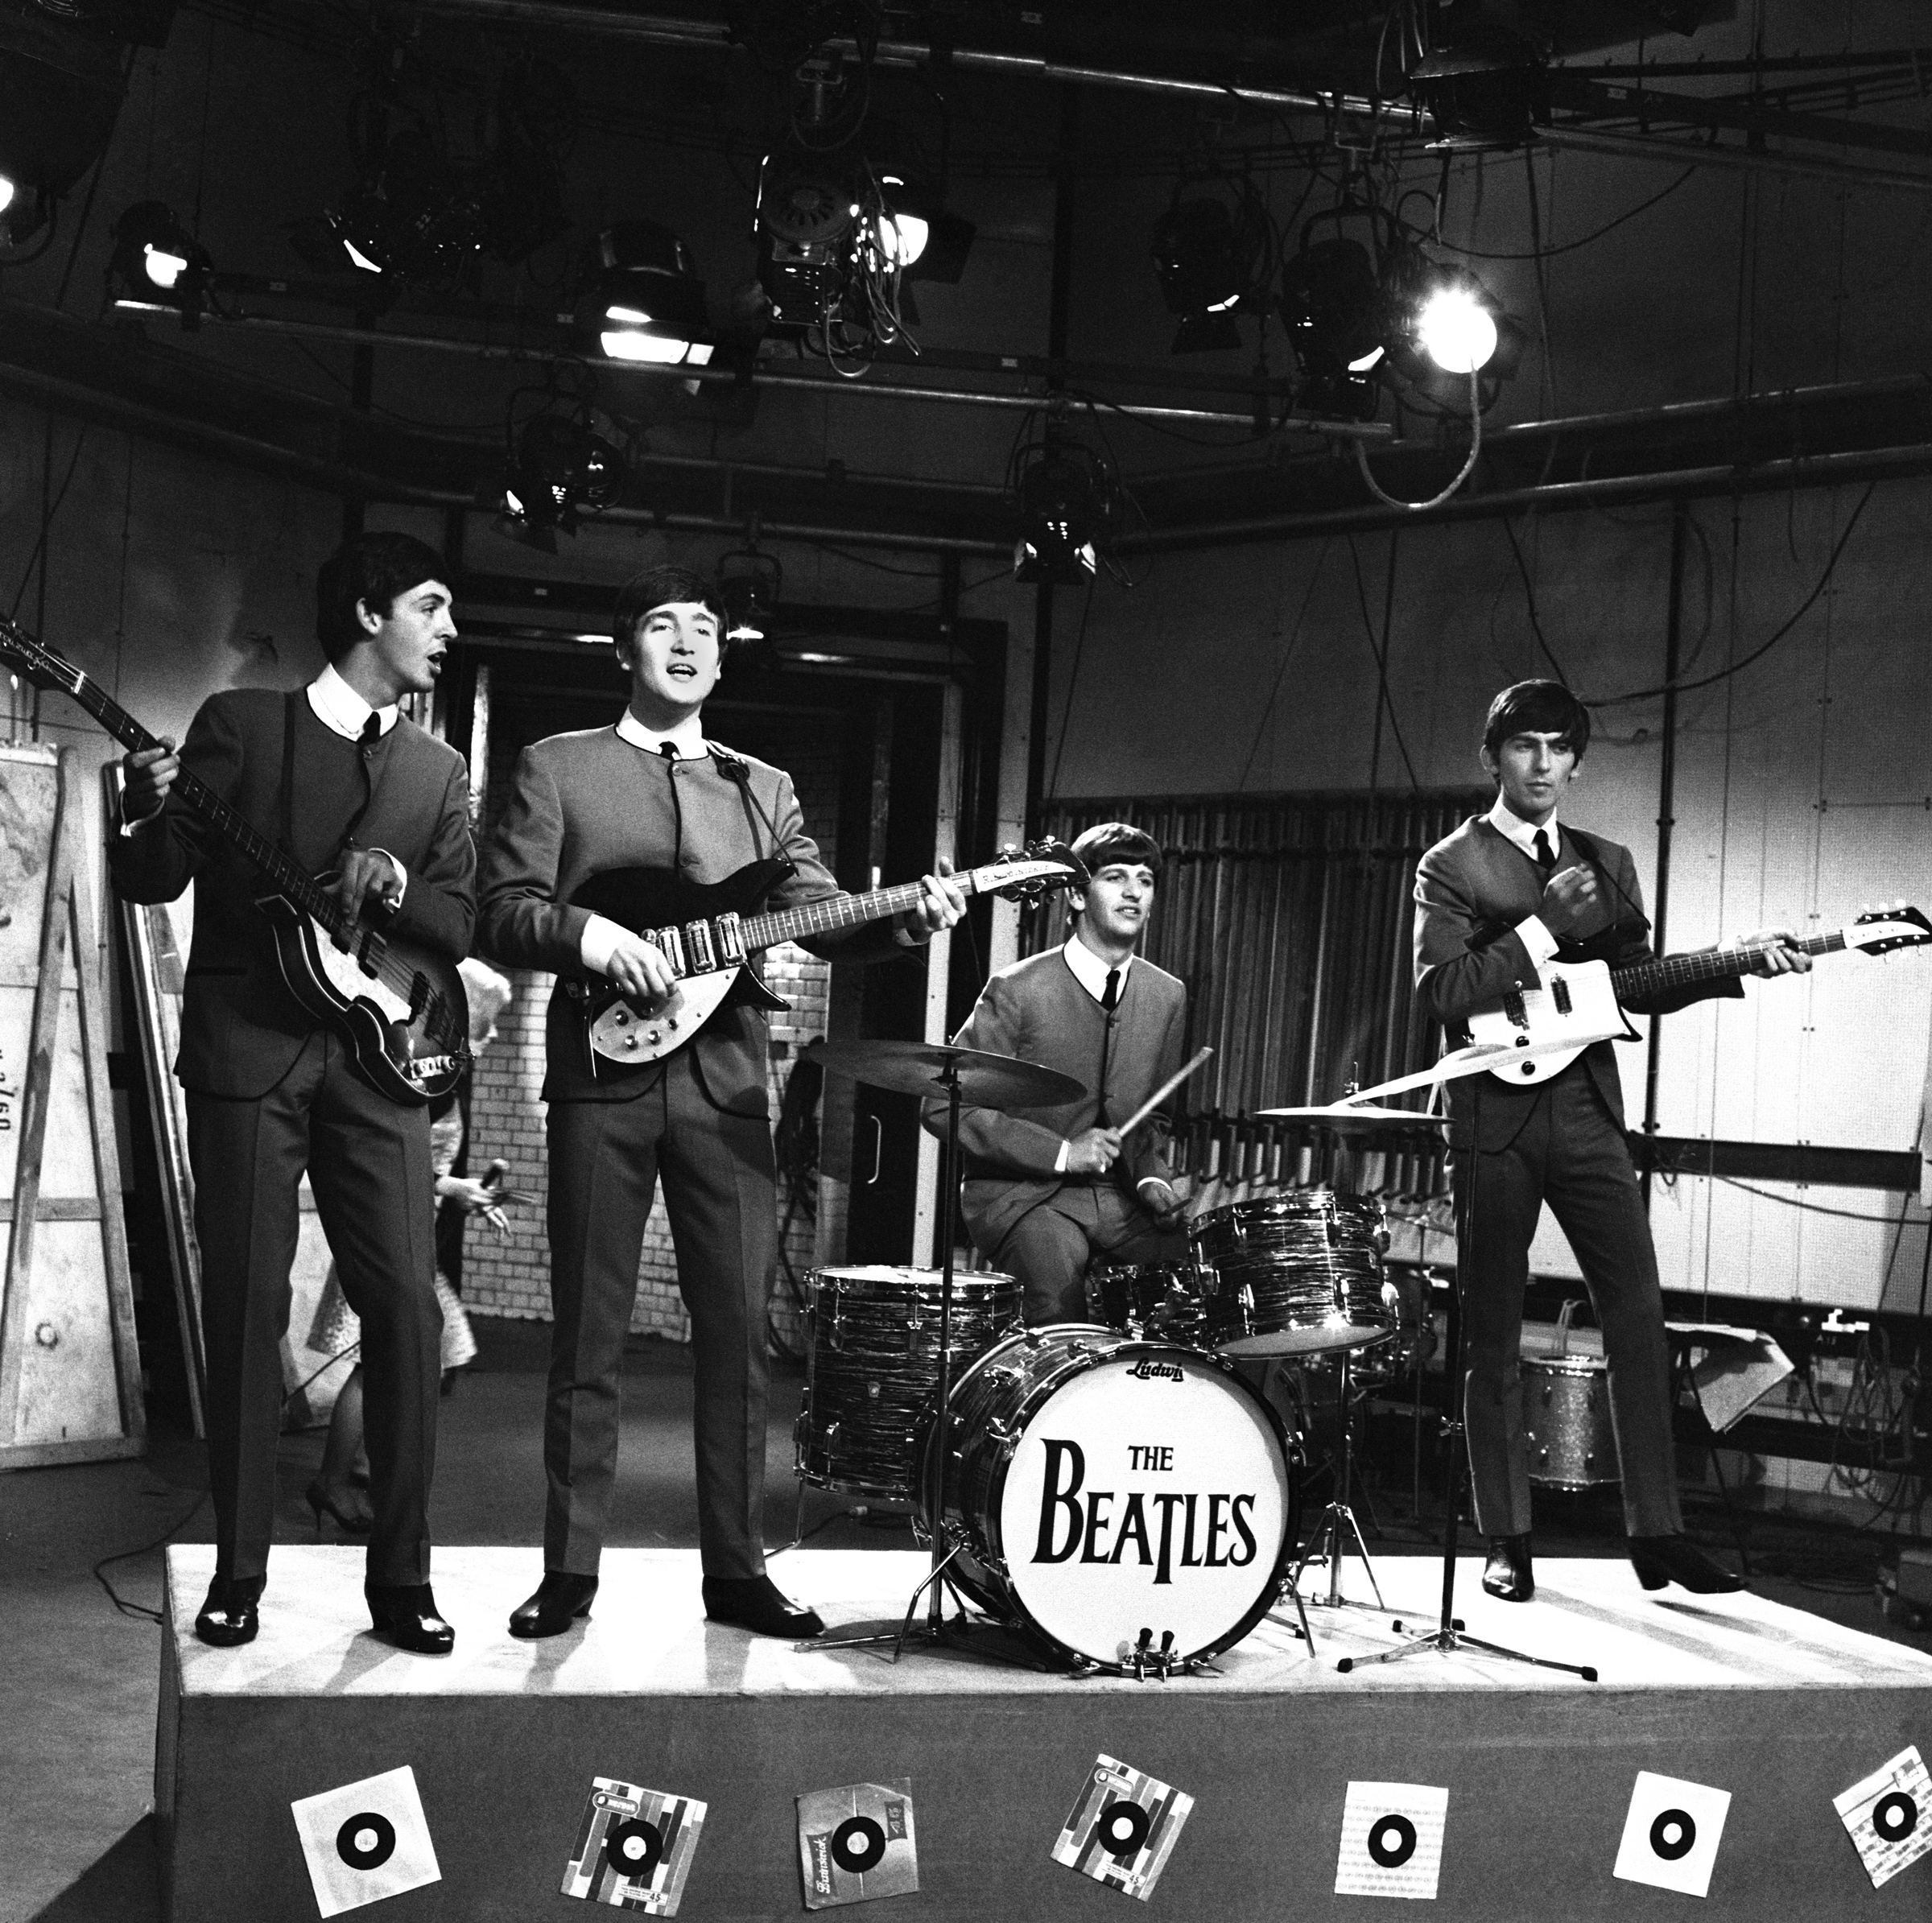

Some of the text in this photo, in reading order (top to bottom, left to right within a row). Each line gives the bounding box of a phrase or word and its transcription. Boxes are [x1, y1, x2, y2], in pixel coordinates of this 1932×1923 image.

[1128, 1445, 1174, 1471] THE
[1030, 1438, 1257, 1584] BEATLES
[1129, 1874, 1140, 1885] 45
[650, 1892, 662, 1902] 45
